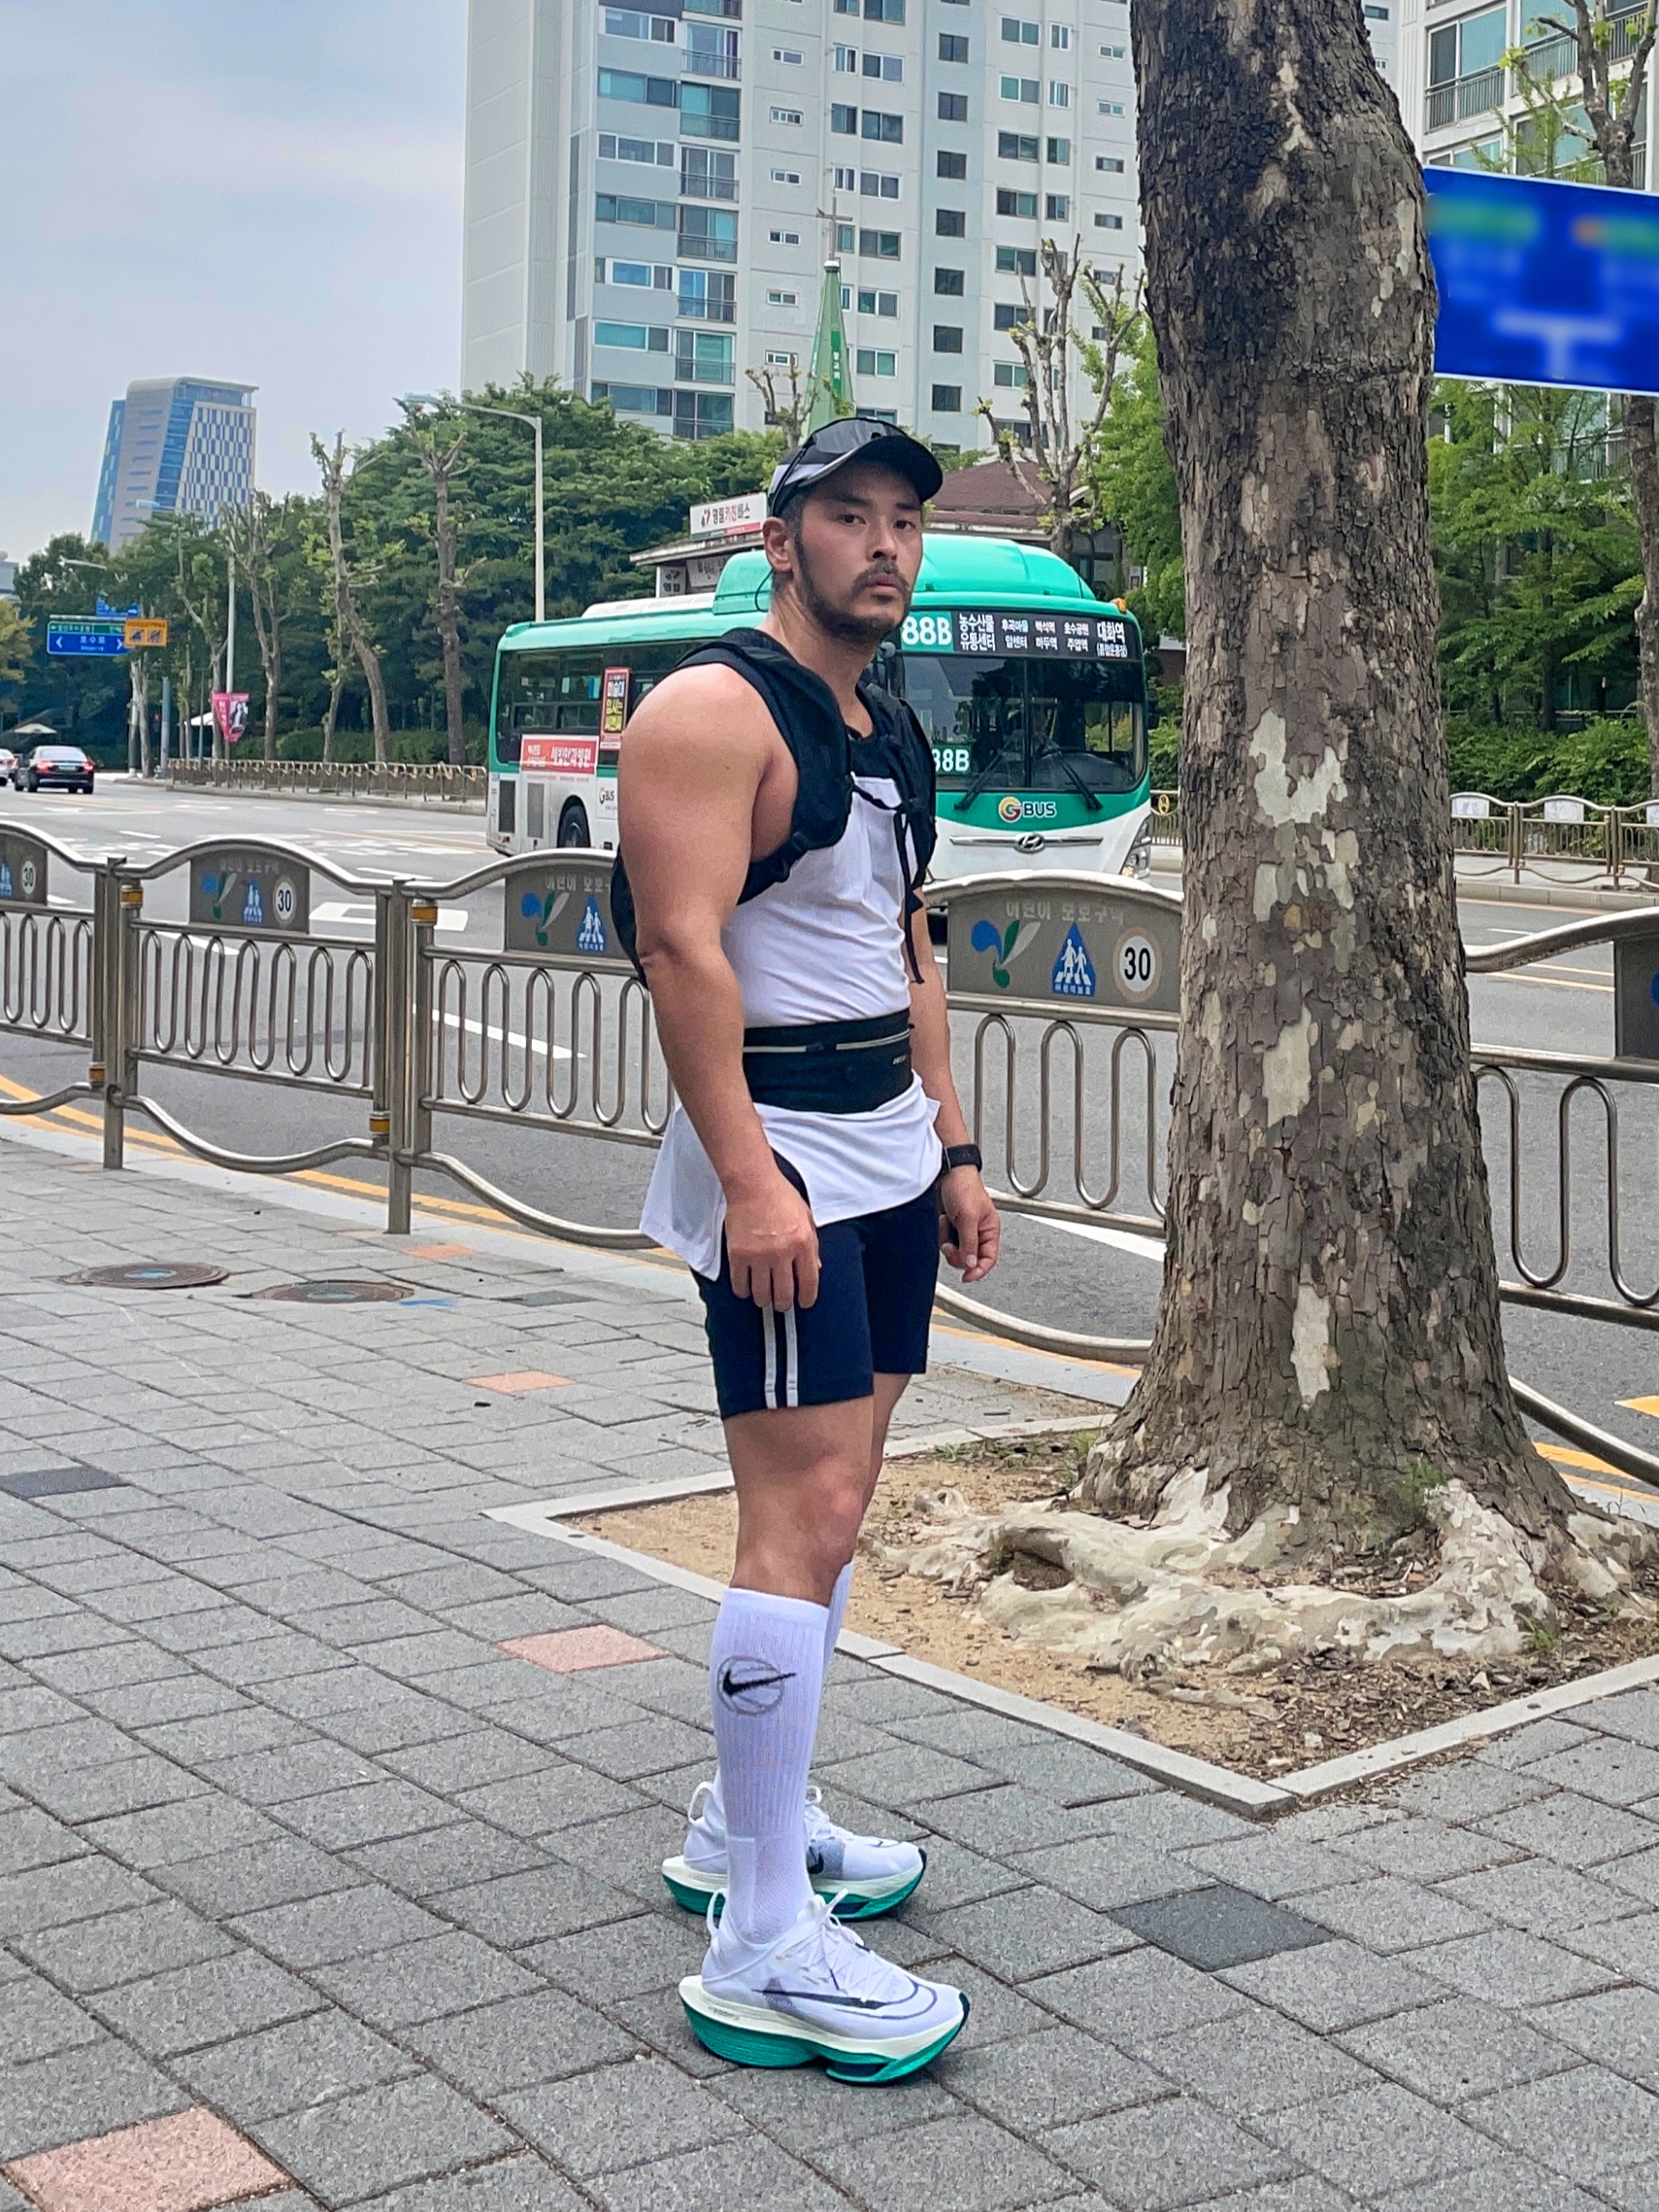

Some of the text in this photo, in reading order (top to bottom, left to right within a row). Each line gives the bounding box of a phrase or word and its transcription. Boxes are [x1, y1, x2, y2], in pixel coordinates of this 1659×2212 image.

[902, 616, 952, 645] 88B
[959, 612, 994, 633] 농수산물
[1097, 621, 1125, 644] 대화역
[960, 633, 996, 651] 유통센터
[1005, 635, 1028, 649] 암센터
[1035, 637, 1058, 650] 마두역
[1067, 638, 1088, 652] 주엽역
[278, 889, 292, 912] 30
[1006, 901, 1050, 920] 어린이
[1123, 946, 1151, 981] 30
